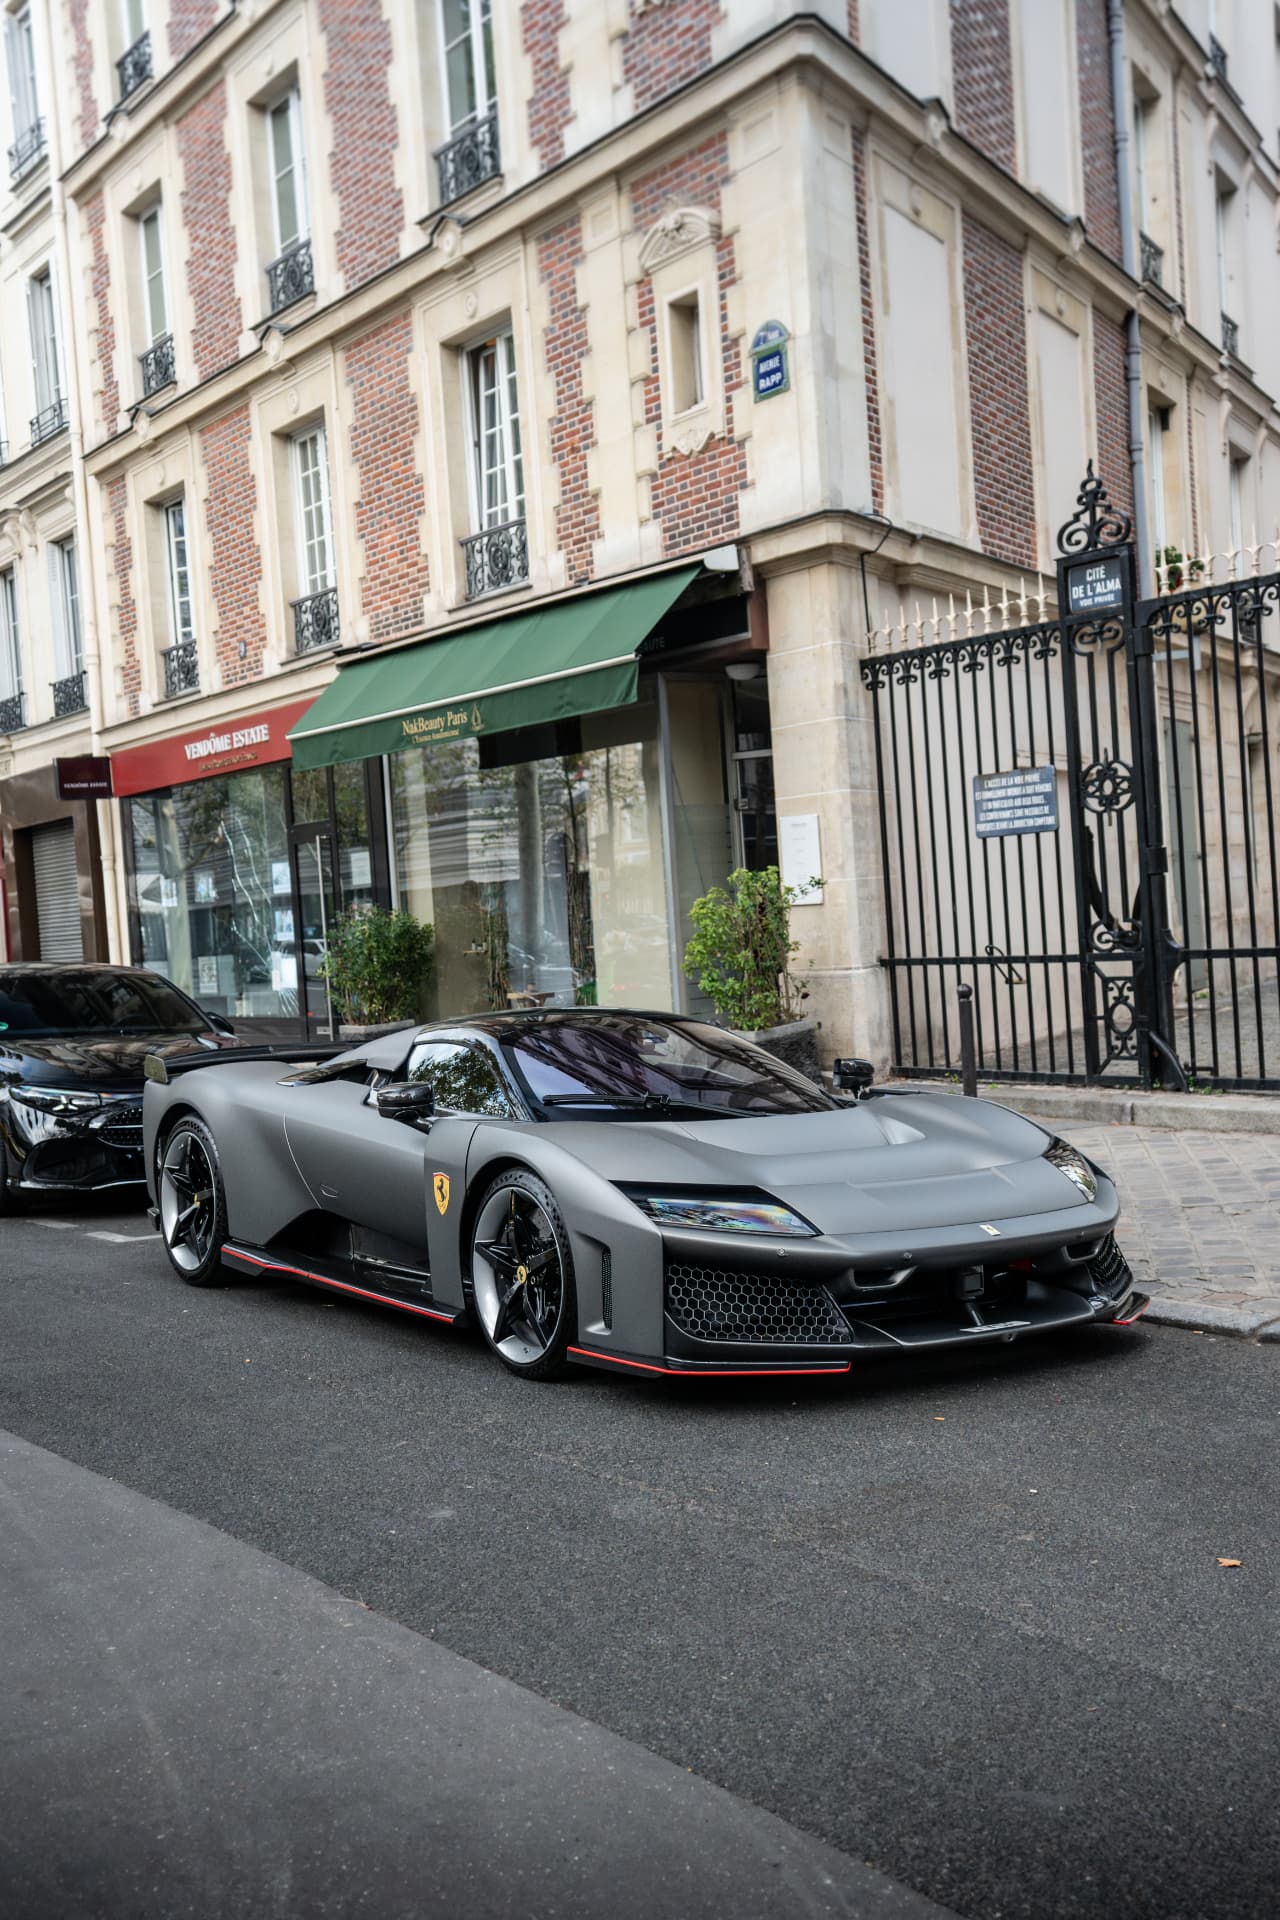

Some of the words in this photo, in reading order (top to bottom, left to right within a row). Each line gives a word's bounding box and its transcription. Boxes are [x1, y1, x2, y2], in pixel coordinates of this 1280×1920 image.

[759, 372, 782, 391] RAPP
[1086, 564, 1106, 581] CITÉ
[1072, 585, 1084, 599] DE
[1087, 577, 1121, 596] L'ALMA
[402, 716, 445, 735] NakBeauty
[447, 708, 467, 726] Paris
[184, 732, 232, 760] VENDÔME
[232, 724, 270, 748] ESTATE
